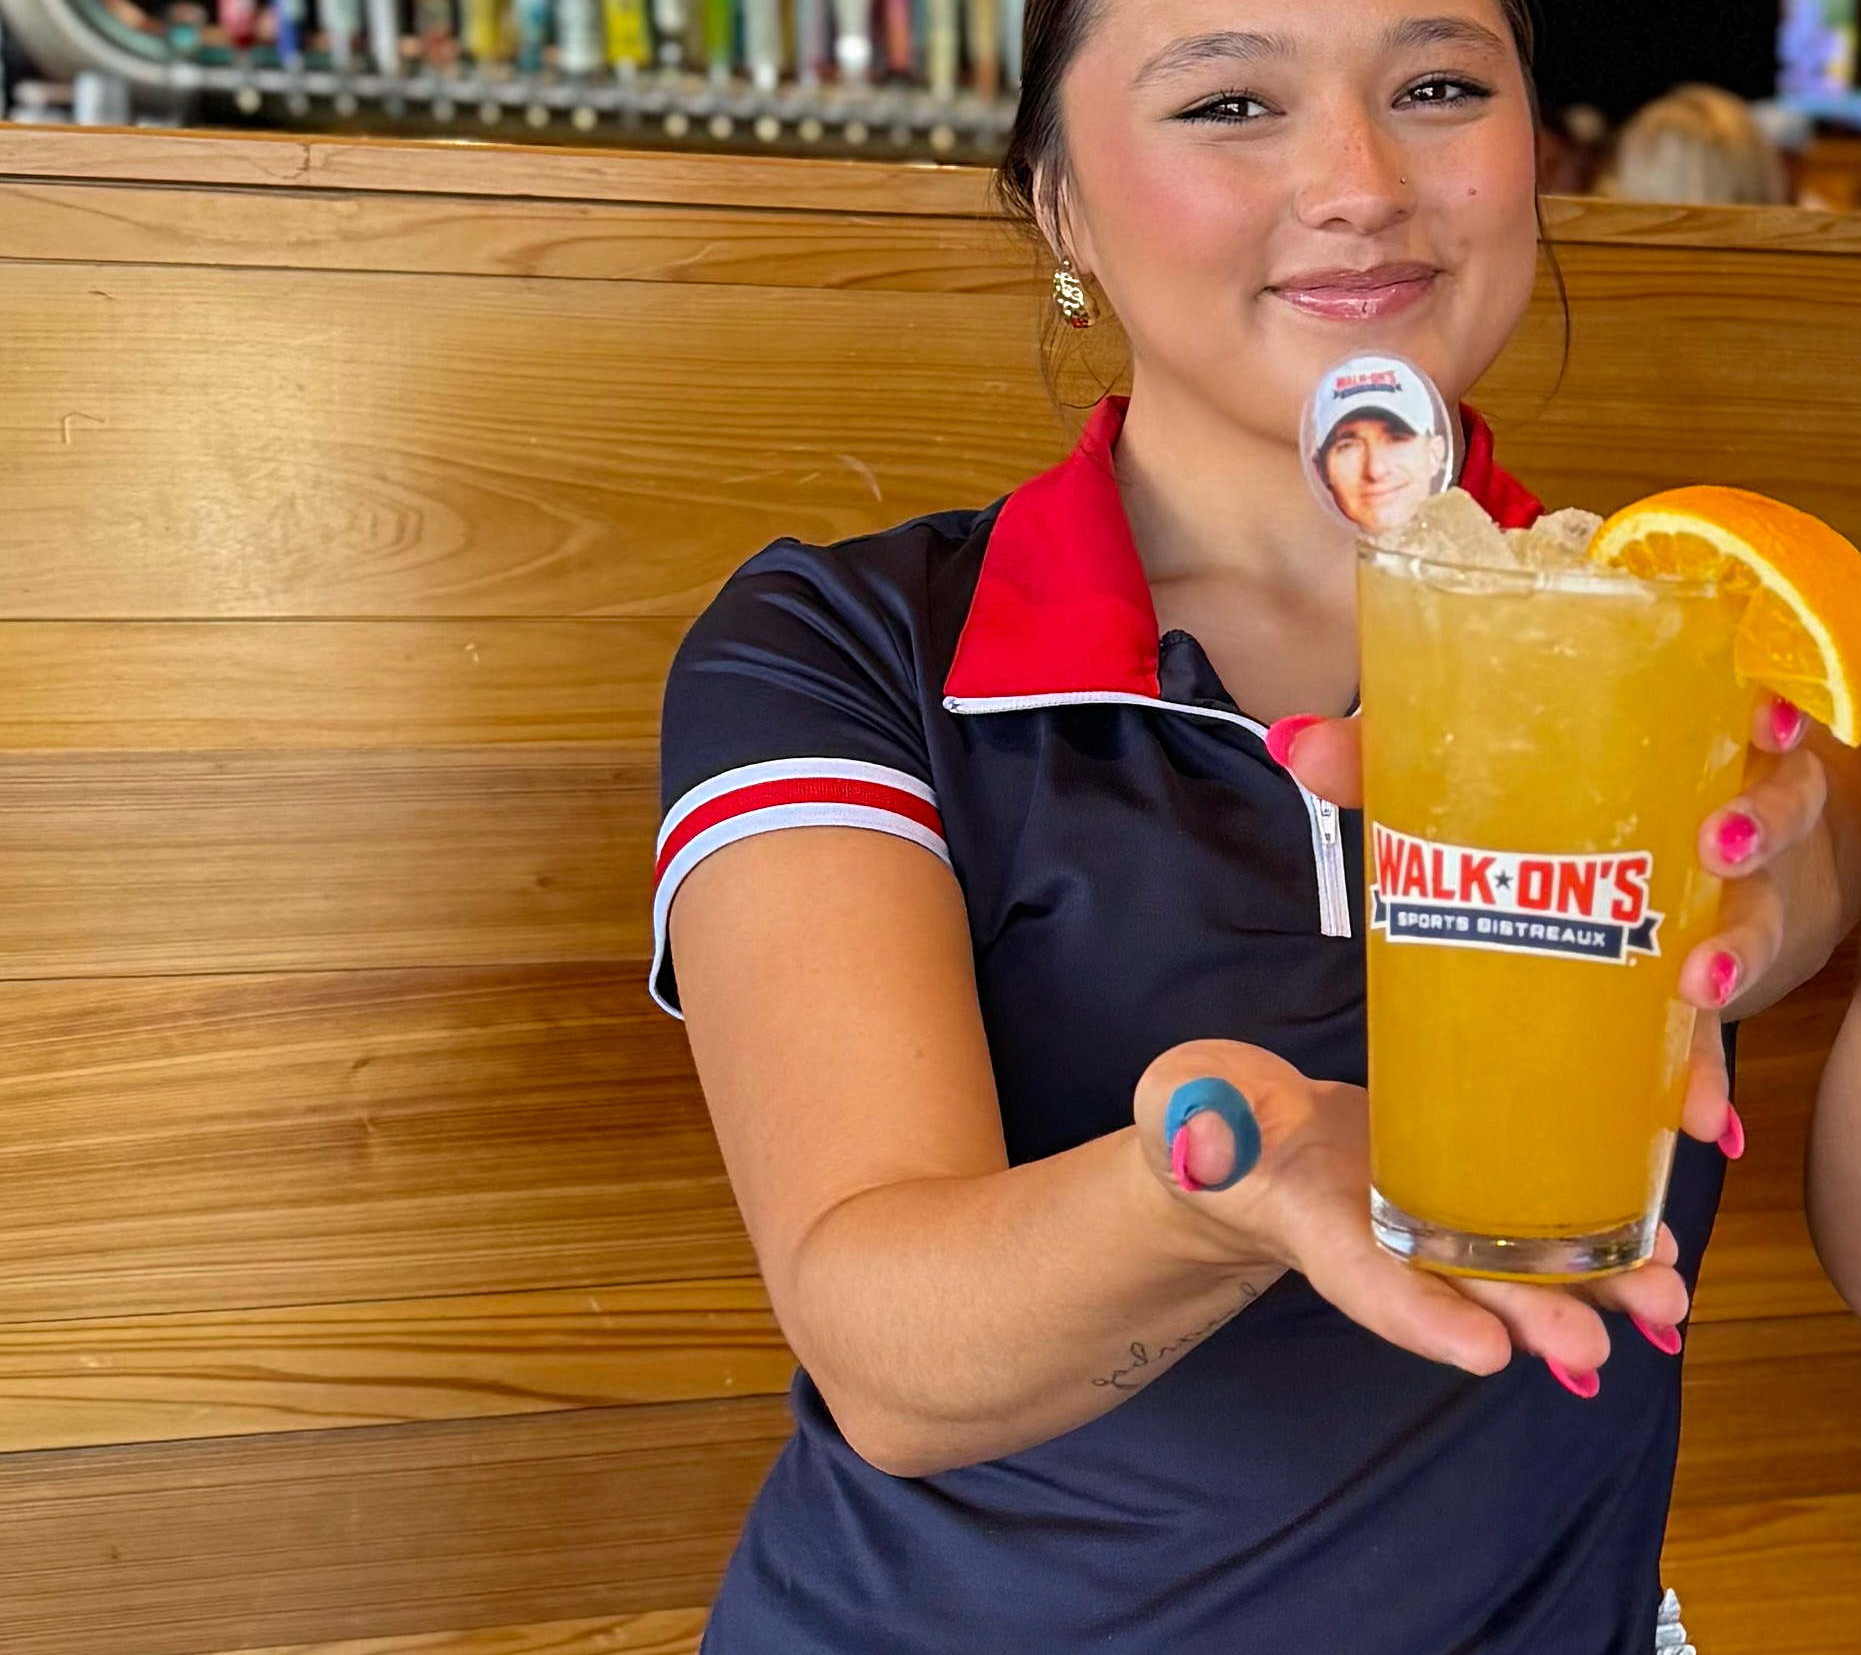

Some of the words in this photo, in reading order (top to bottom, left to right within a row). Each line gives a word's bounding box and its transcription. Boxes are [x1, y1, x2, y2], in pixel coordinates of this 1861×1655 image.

[1376, 826, 1497, 906] WALK
[1516, 856, 1648, 924] ON'S
[1396, 910, 1470, 933] SPORTS
[1476, 917, 1607, 948] BISTREAUX
